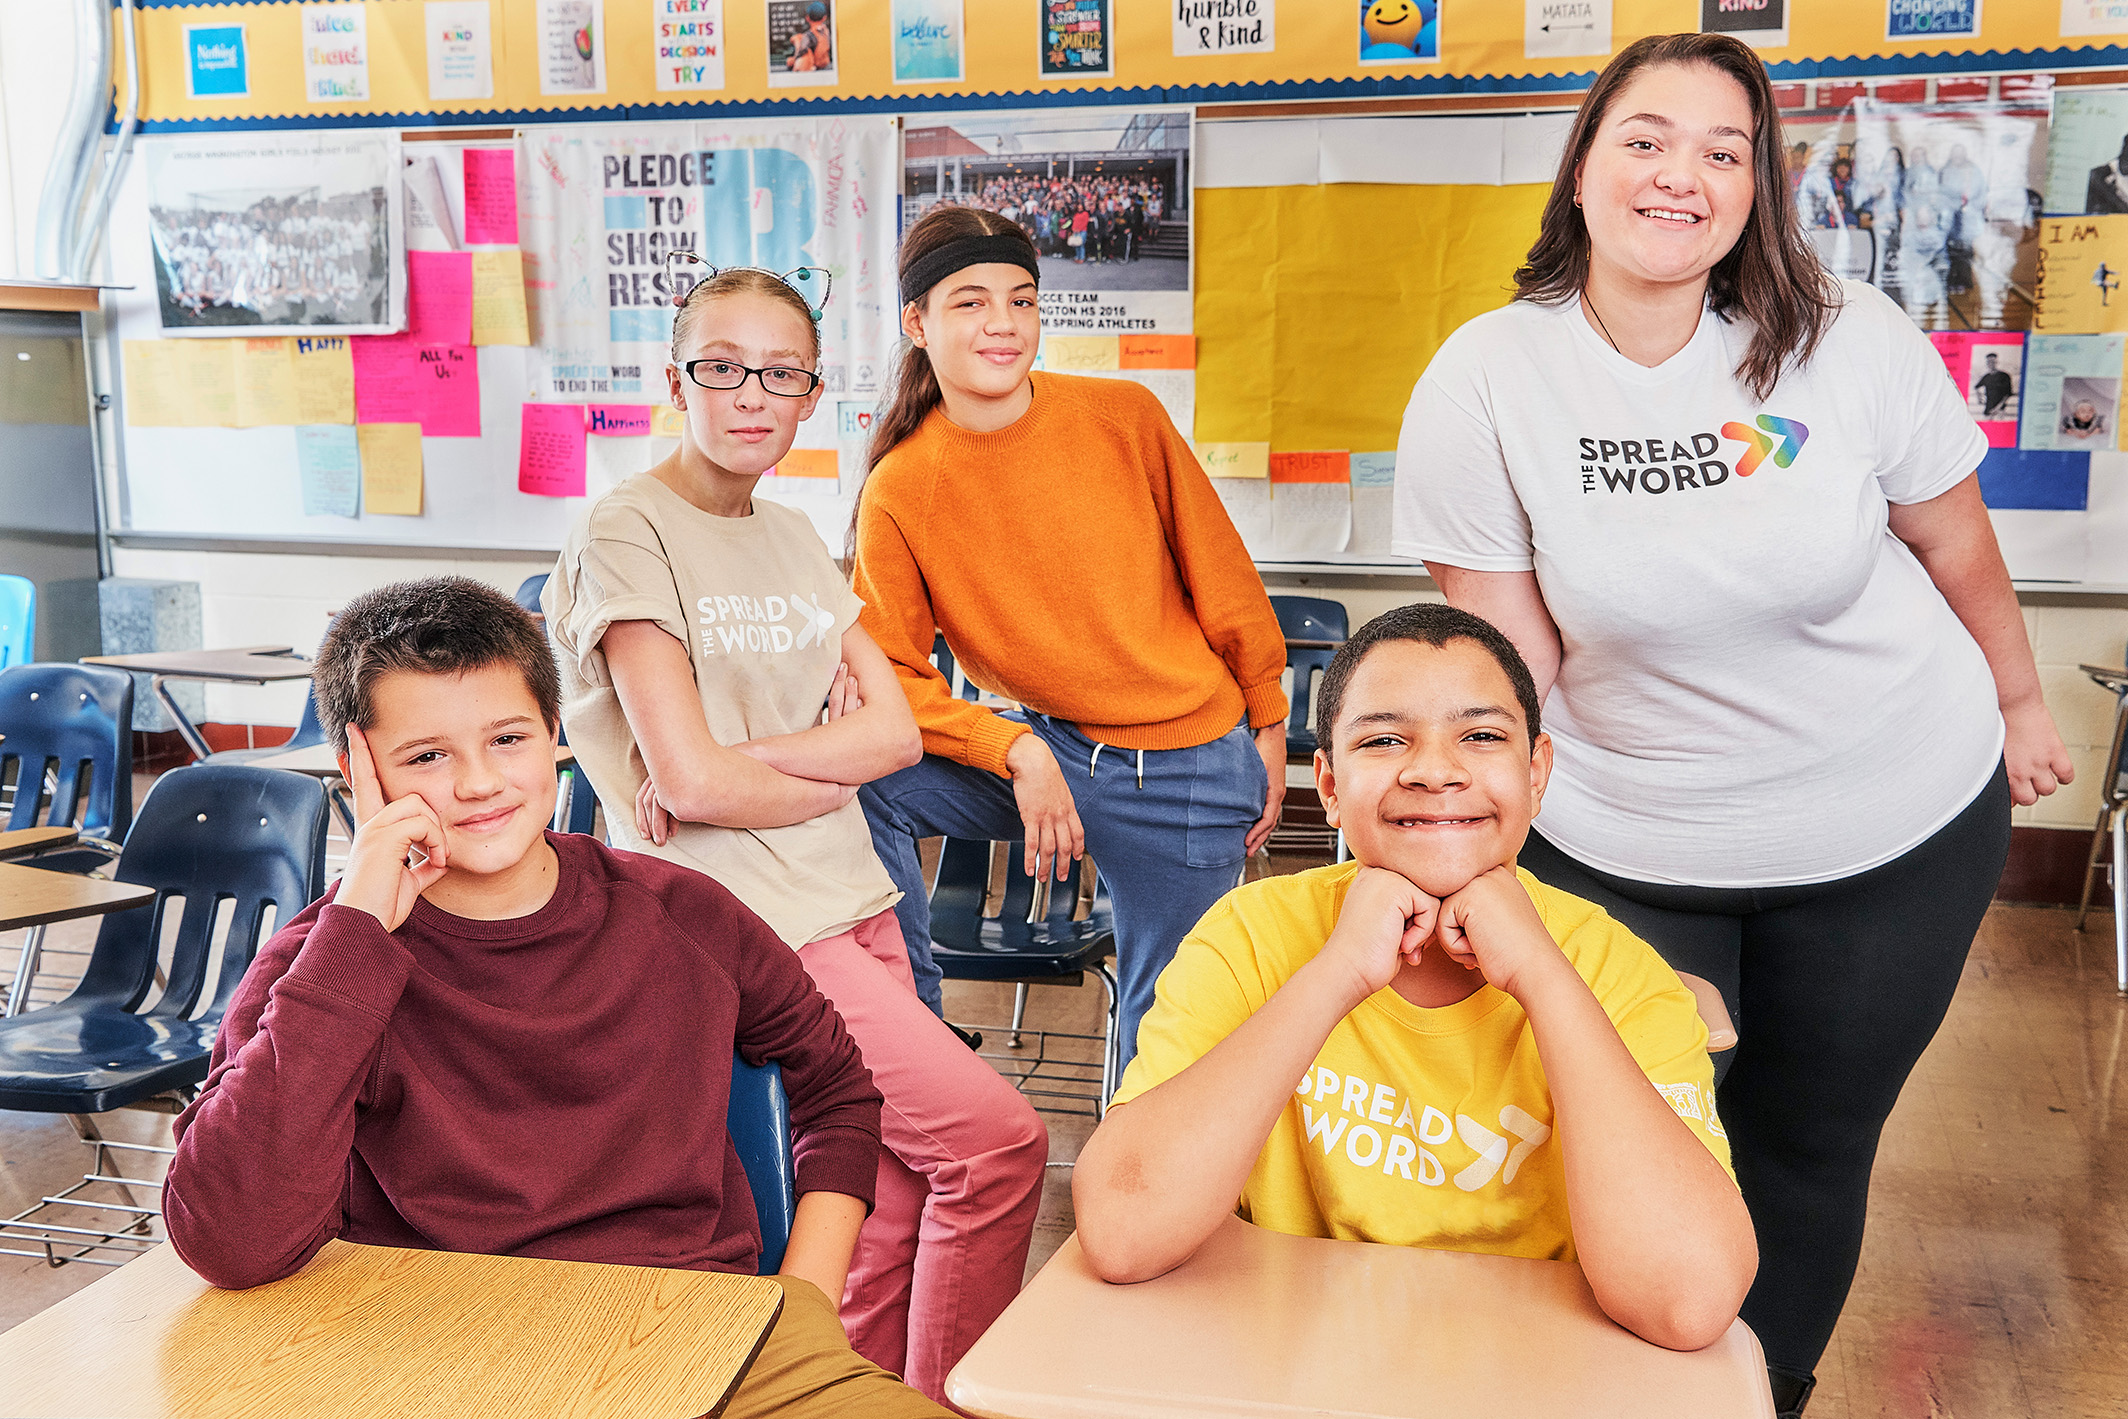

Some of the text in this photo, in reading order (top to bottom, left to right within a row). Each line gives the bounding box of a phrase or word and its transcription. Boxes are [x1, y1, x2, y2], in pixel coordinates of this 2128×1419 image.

[667, 0, 709, 13] EVERY
[1178, 0, 1260, 28] humble
[1542, 4, 1593, 18] MATATA
[443, 30, 473, 42] KIND
[661, 22, 714, 37] STARTS
[1199, 27, 1211, 49] &
[673, 66, 706, 84] TRY
[603, 152, 716, 188] PLEDGE
[649, 196, 684, 226] TO
[607, 232, 698, 266] SHOW
[1068, 293, 1099, 303] TEAM
[1081, 306, 1096, 316] HS
[1100, 306, 1127, 317] 2016
[1053, 319, 1094, 329] SPRING
[1098, 318, 1156, 329] ATHLETES
[612, 366, 641, 378] WORD
[553, 380, 566, 392] TO
[569, 380, 587, 392] END
[592, 380, 609, 392] THE
[1579, 432, 1719, 464] SPREAD
[1278, 455, 1332, 472] TRUST
[1581, 460, 1730, 495] THE WORD
[697, 594, 789, 625] SPREAD
[701, 624, 794, 658] THE WORD
[1295, 1063, 1453, 1145] SPREAD
[1302, 1103, 1446, 1187] WORD
